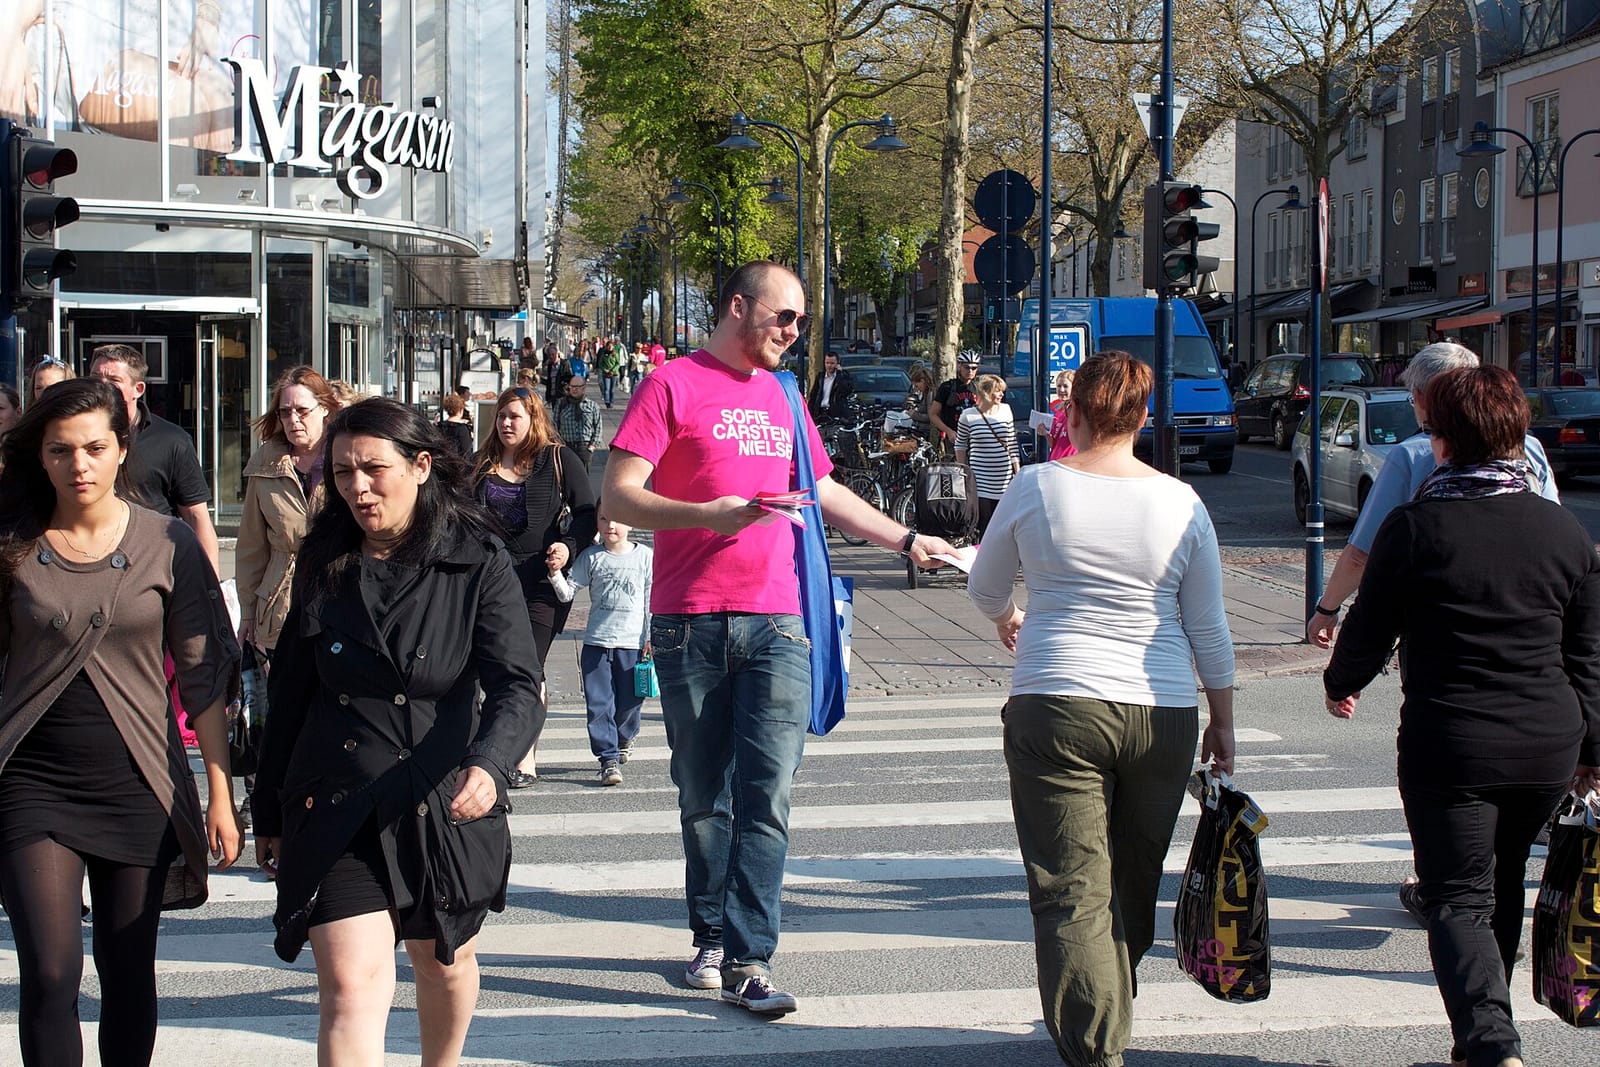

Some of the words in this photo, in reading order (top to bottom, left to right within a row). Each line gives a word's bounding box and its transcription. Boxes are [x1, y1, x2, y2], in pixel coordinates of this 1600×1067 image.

[220, 57, 455, 200] Magasin
[1049, 341, 1076, 360] 20
[720, 408, 771, 426] SOFIE
[712, 423, 792, 443] CARSTEN
